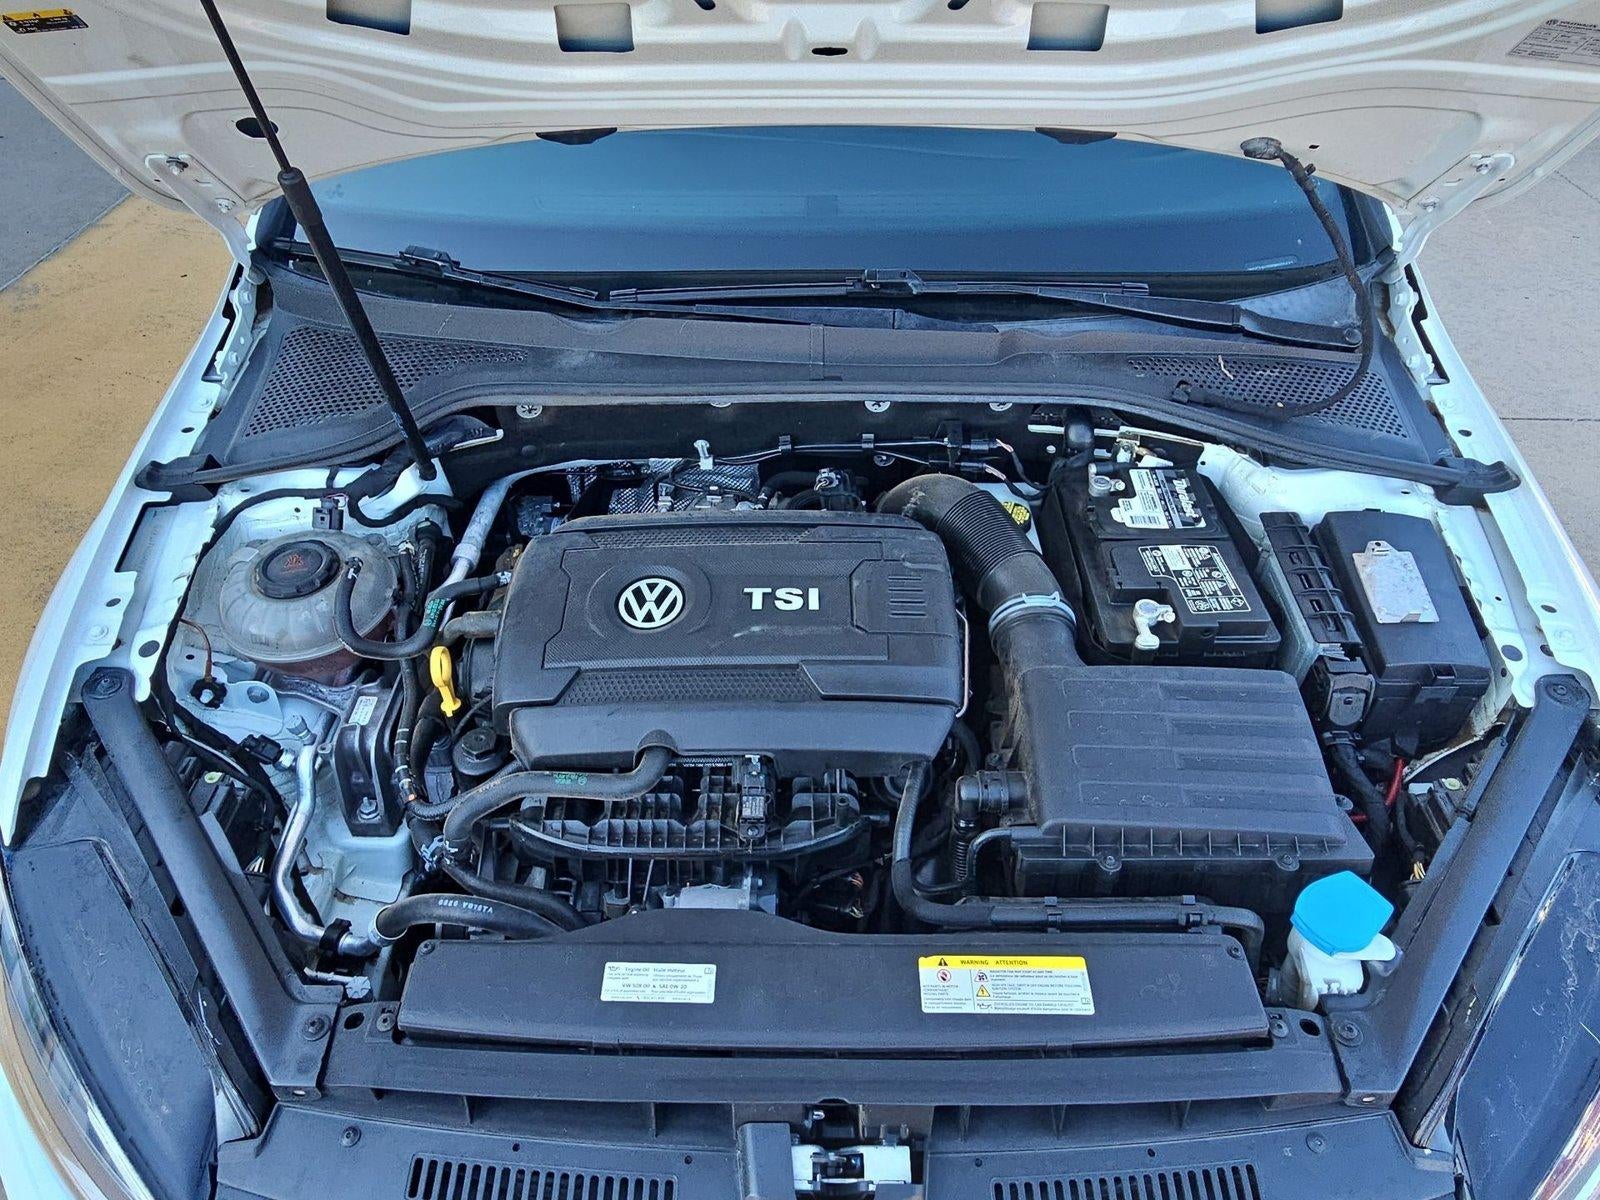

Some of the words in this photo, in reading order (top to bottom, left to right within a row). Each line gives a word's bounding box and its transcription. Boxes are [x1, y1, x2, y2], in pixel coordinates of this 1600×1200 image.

[1172, 478, 1200, 518] Duralast
[618, 577, 684, 629] VW
[743, 587, 820, 611] TSI
